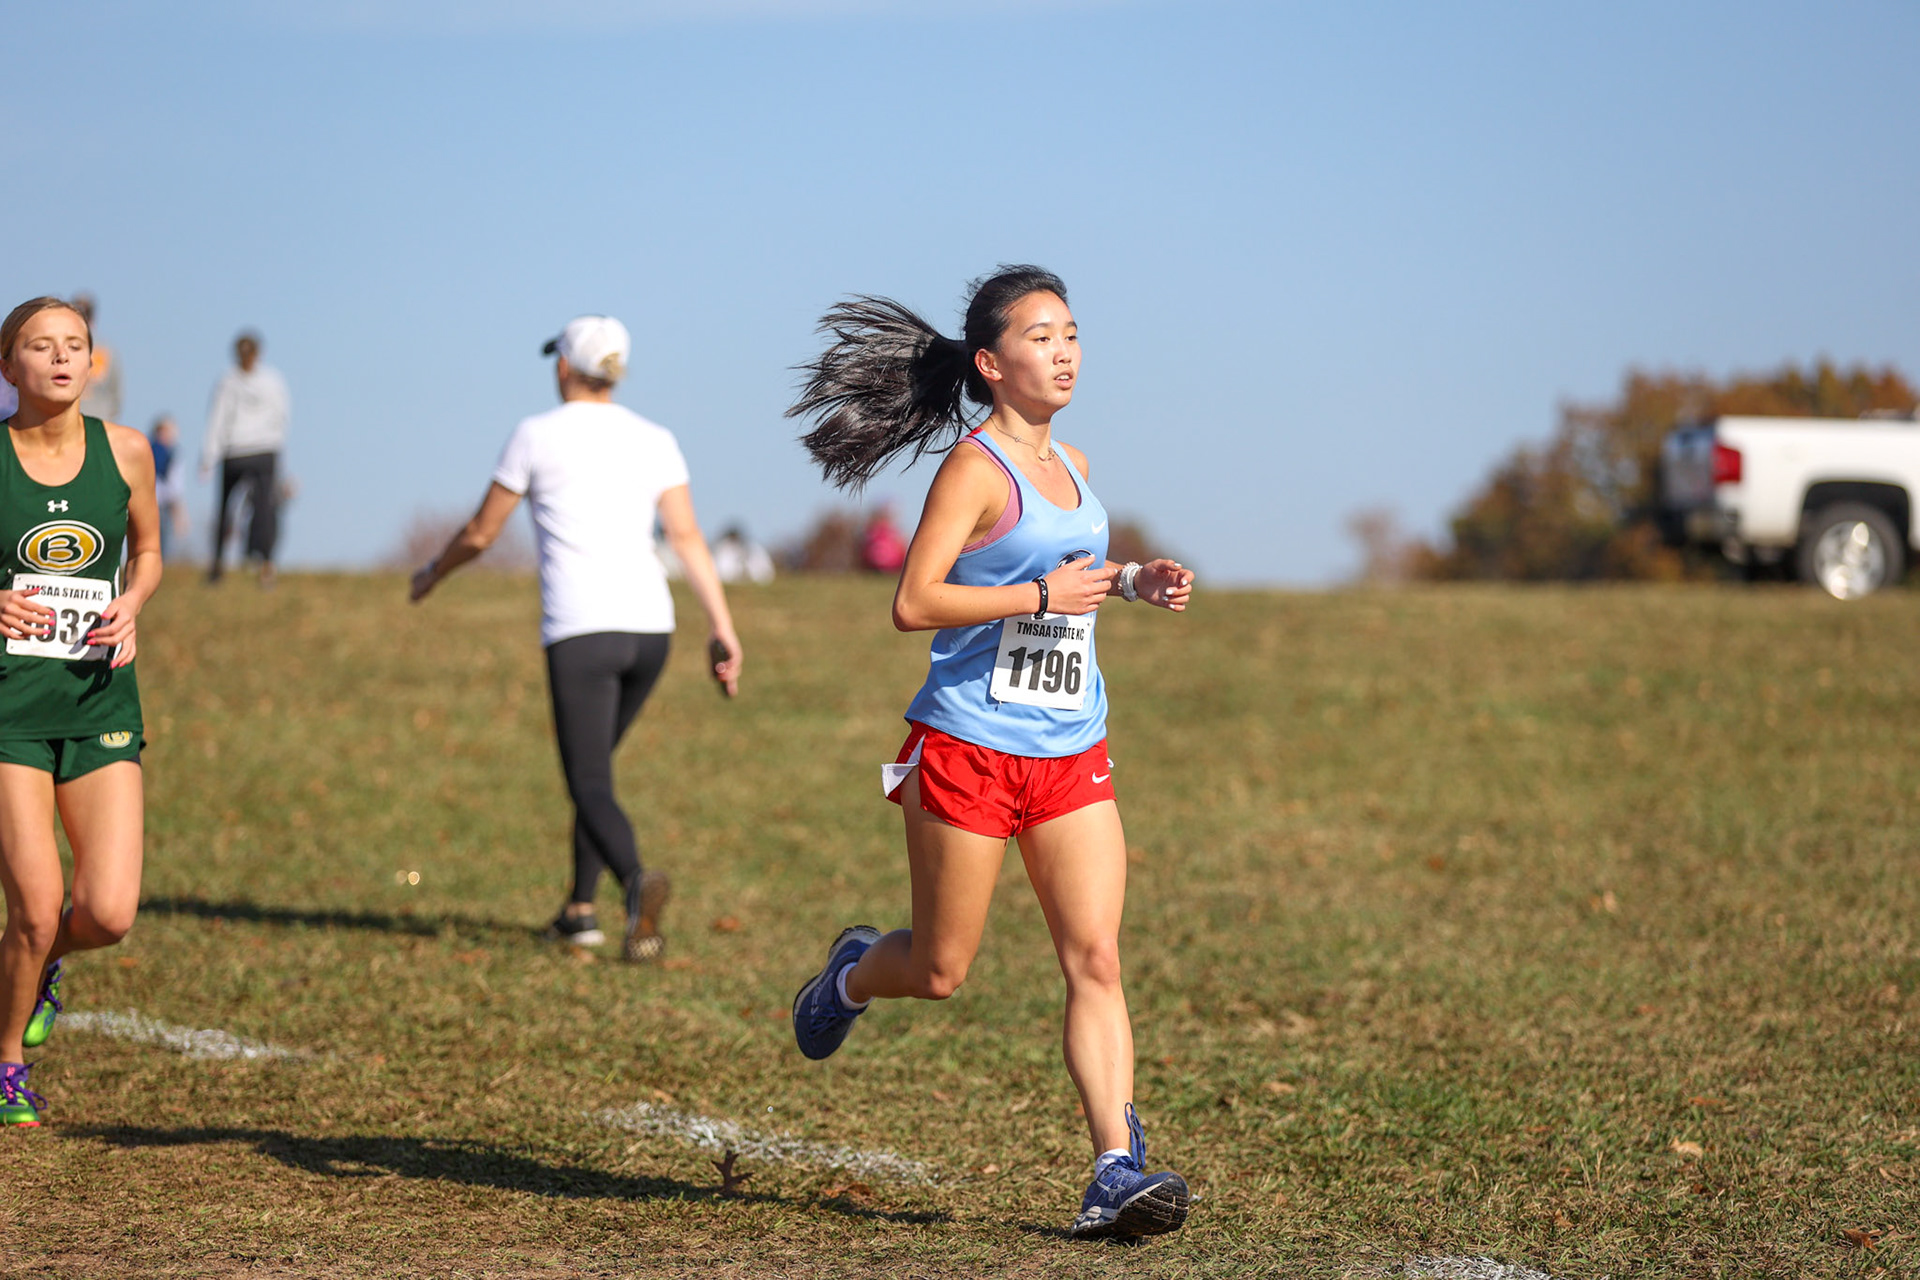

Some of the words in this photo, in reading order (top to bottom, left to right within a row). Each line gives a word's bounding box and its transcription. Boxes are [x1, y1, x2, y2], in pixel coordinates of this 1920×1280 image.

[62, 588, 90, 600] STATE
[92, 590, 104, 601] XC
[20, 606, 103, 646] 032
[1017, 621, 1051, 637] TMSAA
[1053, 625, 1075, 640] STATE
[1076, 628, 1085, 641] XC
[1008, 646, 1082, 695] 1196
